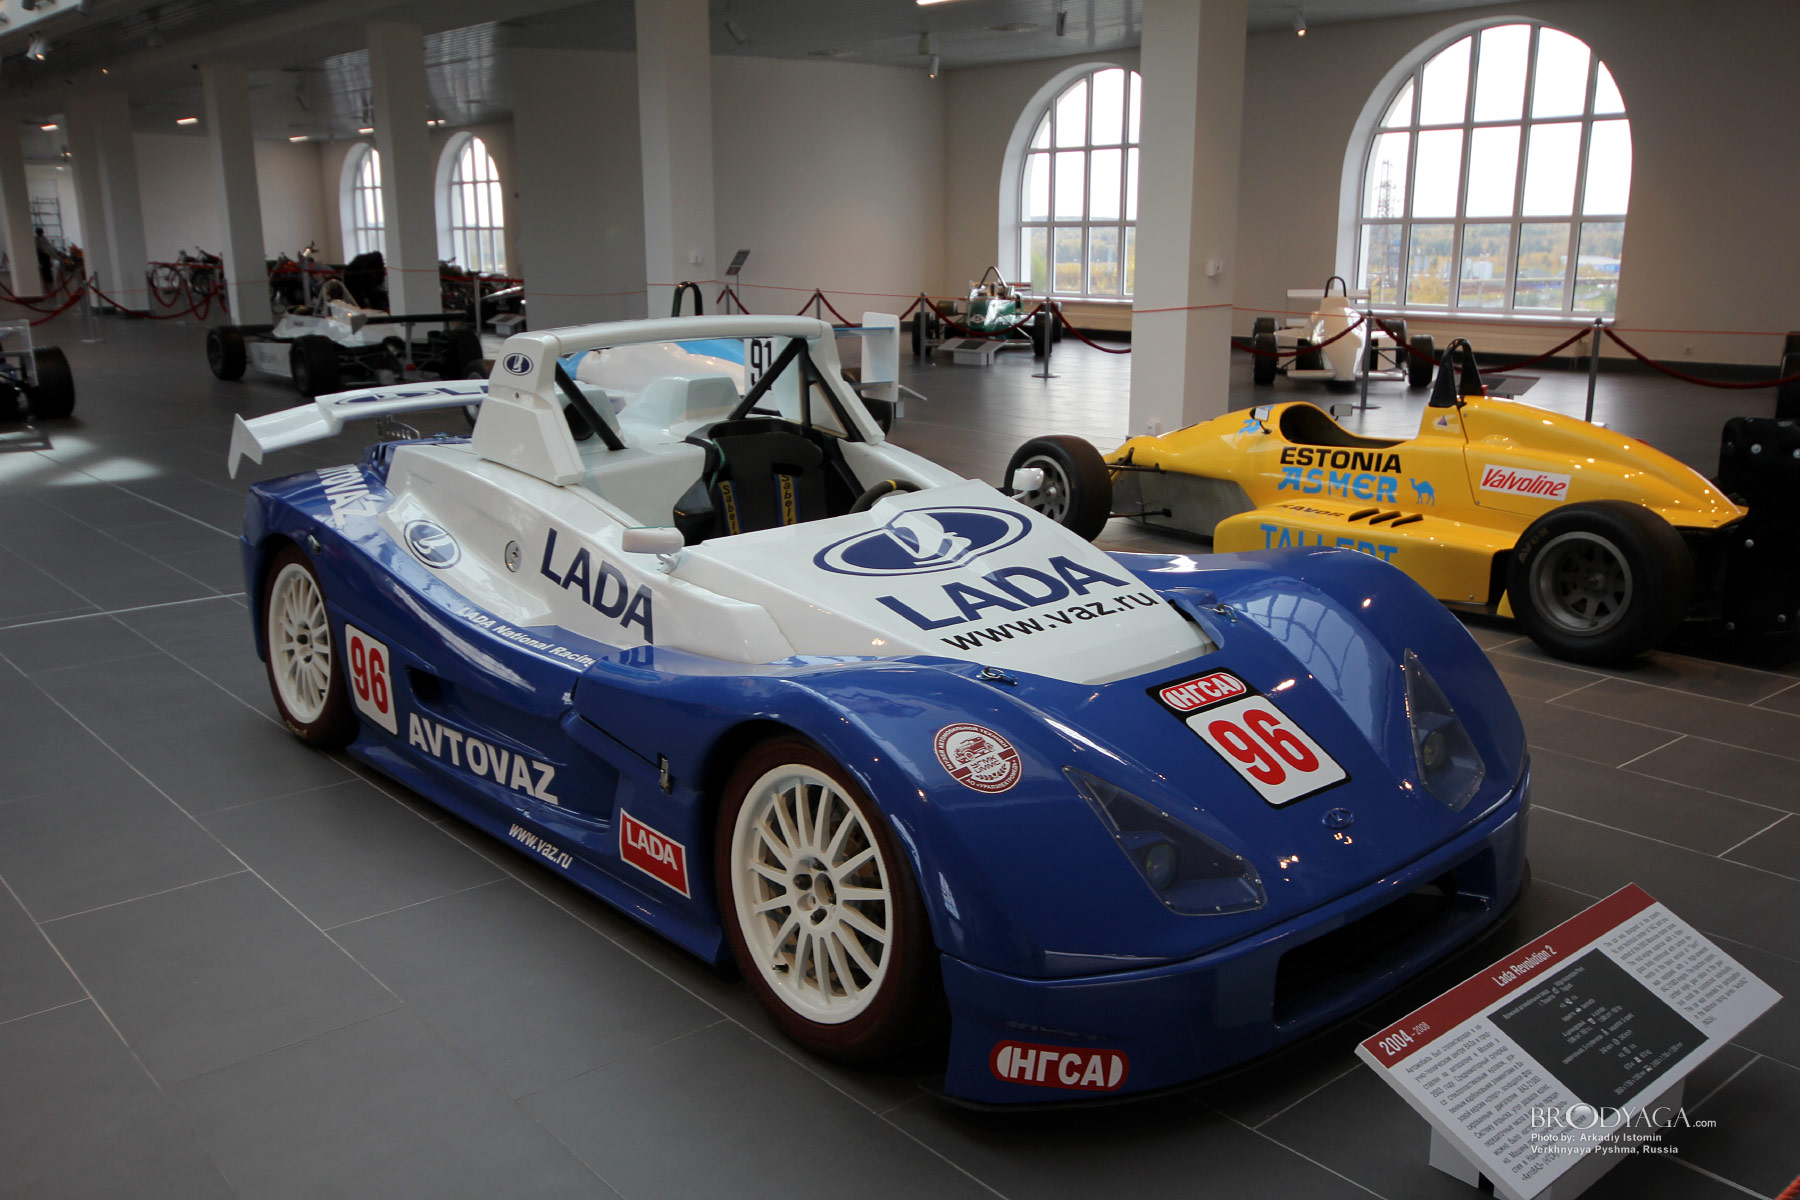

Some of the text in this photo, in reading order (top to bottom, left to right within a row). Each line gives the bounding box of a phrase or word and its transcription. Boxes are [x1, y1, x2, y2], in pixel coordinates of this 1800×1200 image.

[751, 339, 772, 390] 91
[1280, 447, 1402, 474] ESTONIA
[1482, 468, 1567, 497] Valvoline
[1278, 467, 1398, 503] ASMER
[722, 485, 738, 534] Sabel
[540, 528, 654, 643] LADA
[876, 556, 1131, 630] LADA
[460, 606, 497, 628] LADA
[493, 624, 554, 651] National
[940, 592, 1160, 650] www.vaz.ru
[350, 636, 388, 714] 96
[1173, 676, 1235, 708] НГСА
[409, 712, 558, 804] AVTOVAZ
[1208, 709, 1320, 785] 96
[508, 824, 572, 869] www.vaz.ru
[626, 818, 678, 871] LADA
[1492, 970, 1517, 987] Lada
[1510, 950, 1552, 976] Revolution
[1544, 944, 1557, 956] 2
[1378, 1030, 1414, 1056] 2004
[1010, 1047, 1104, 1087] НГСА
